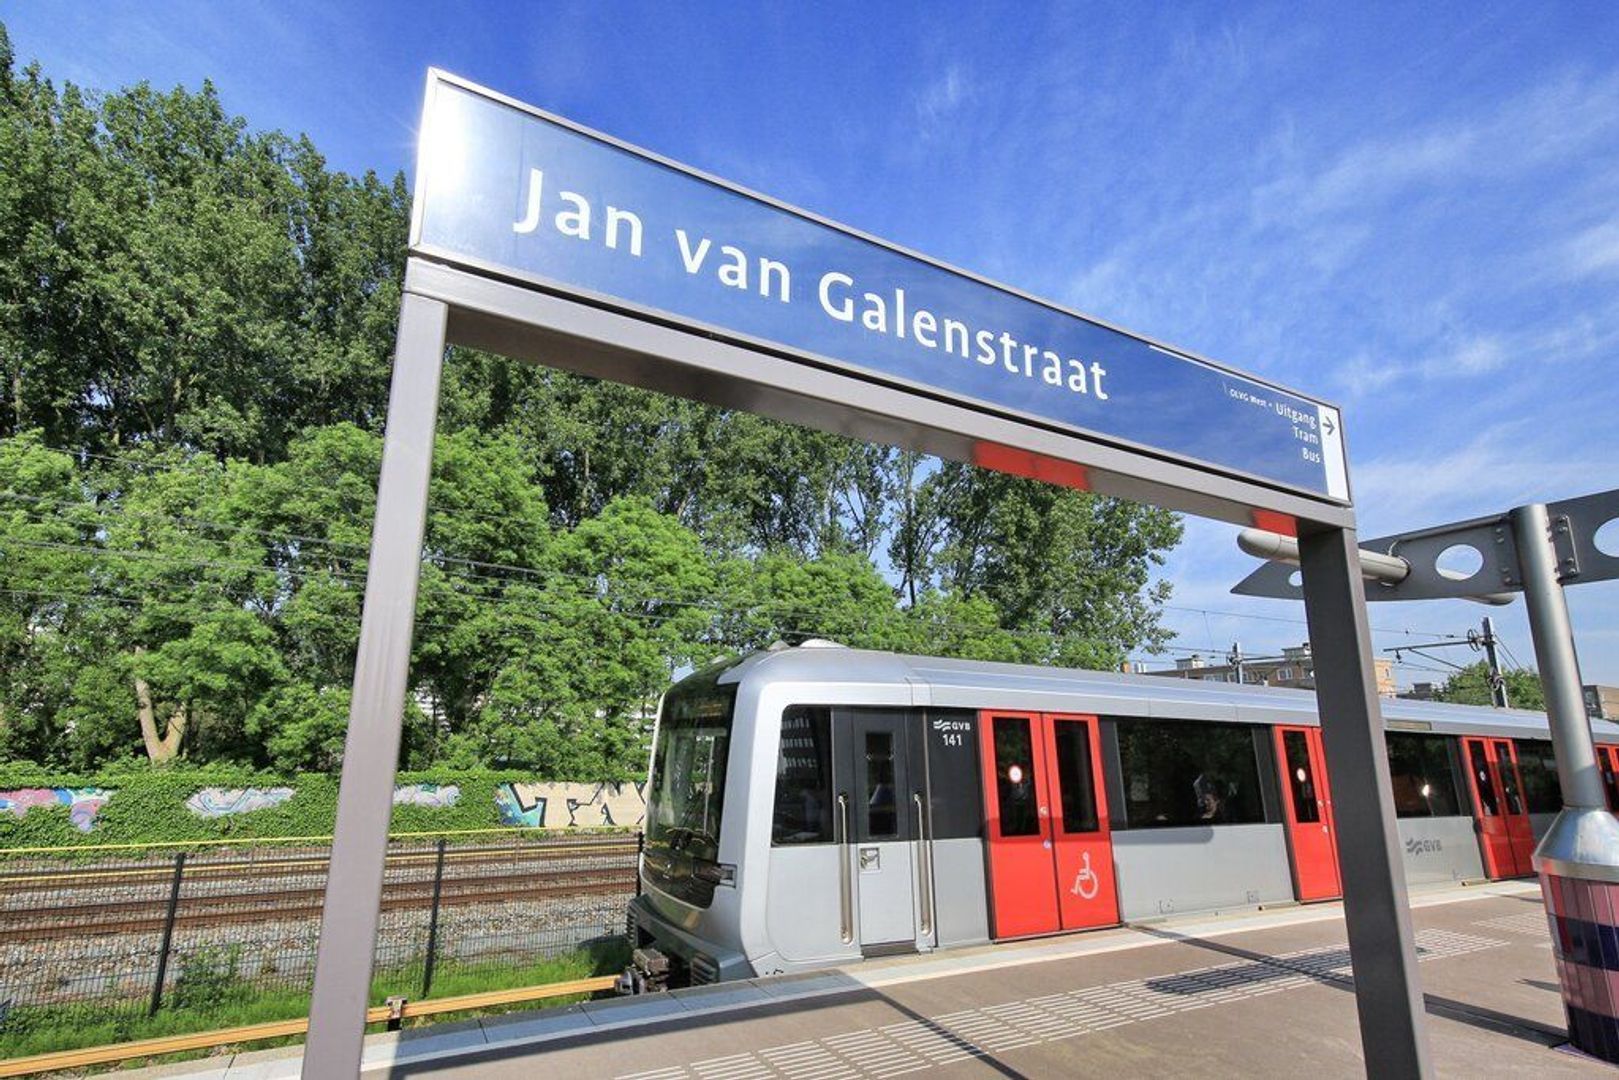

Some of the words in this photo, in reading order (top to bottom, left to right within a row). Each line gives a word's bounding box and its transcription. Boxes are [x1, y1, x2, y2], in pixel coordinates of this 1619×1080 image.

[512, 167, 643, 257] Jan
[675, 229, 791, 303] van
[818, 271, 1109, 400] Galenstraat
[1275, 402, 1317, 430] Uitgang
[1292, 425, 1319, 445] Tram
[1302, 447, 1321, 463] Bus
[952, 721, 971, 731] GVB
[942, 734, 963, 746] 141
